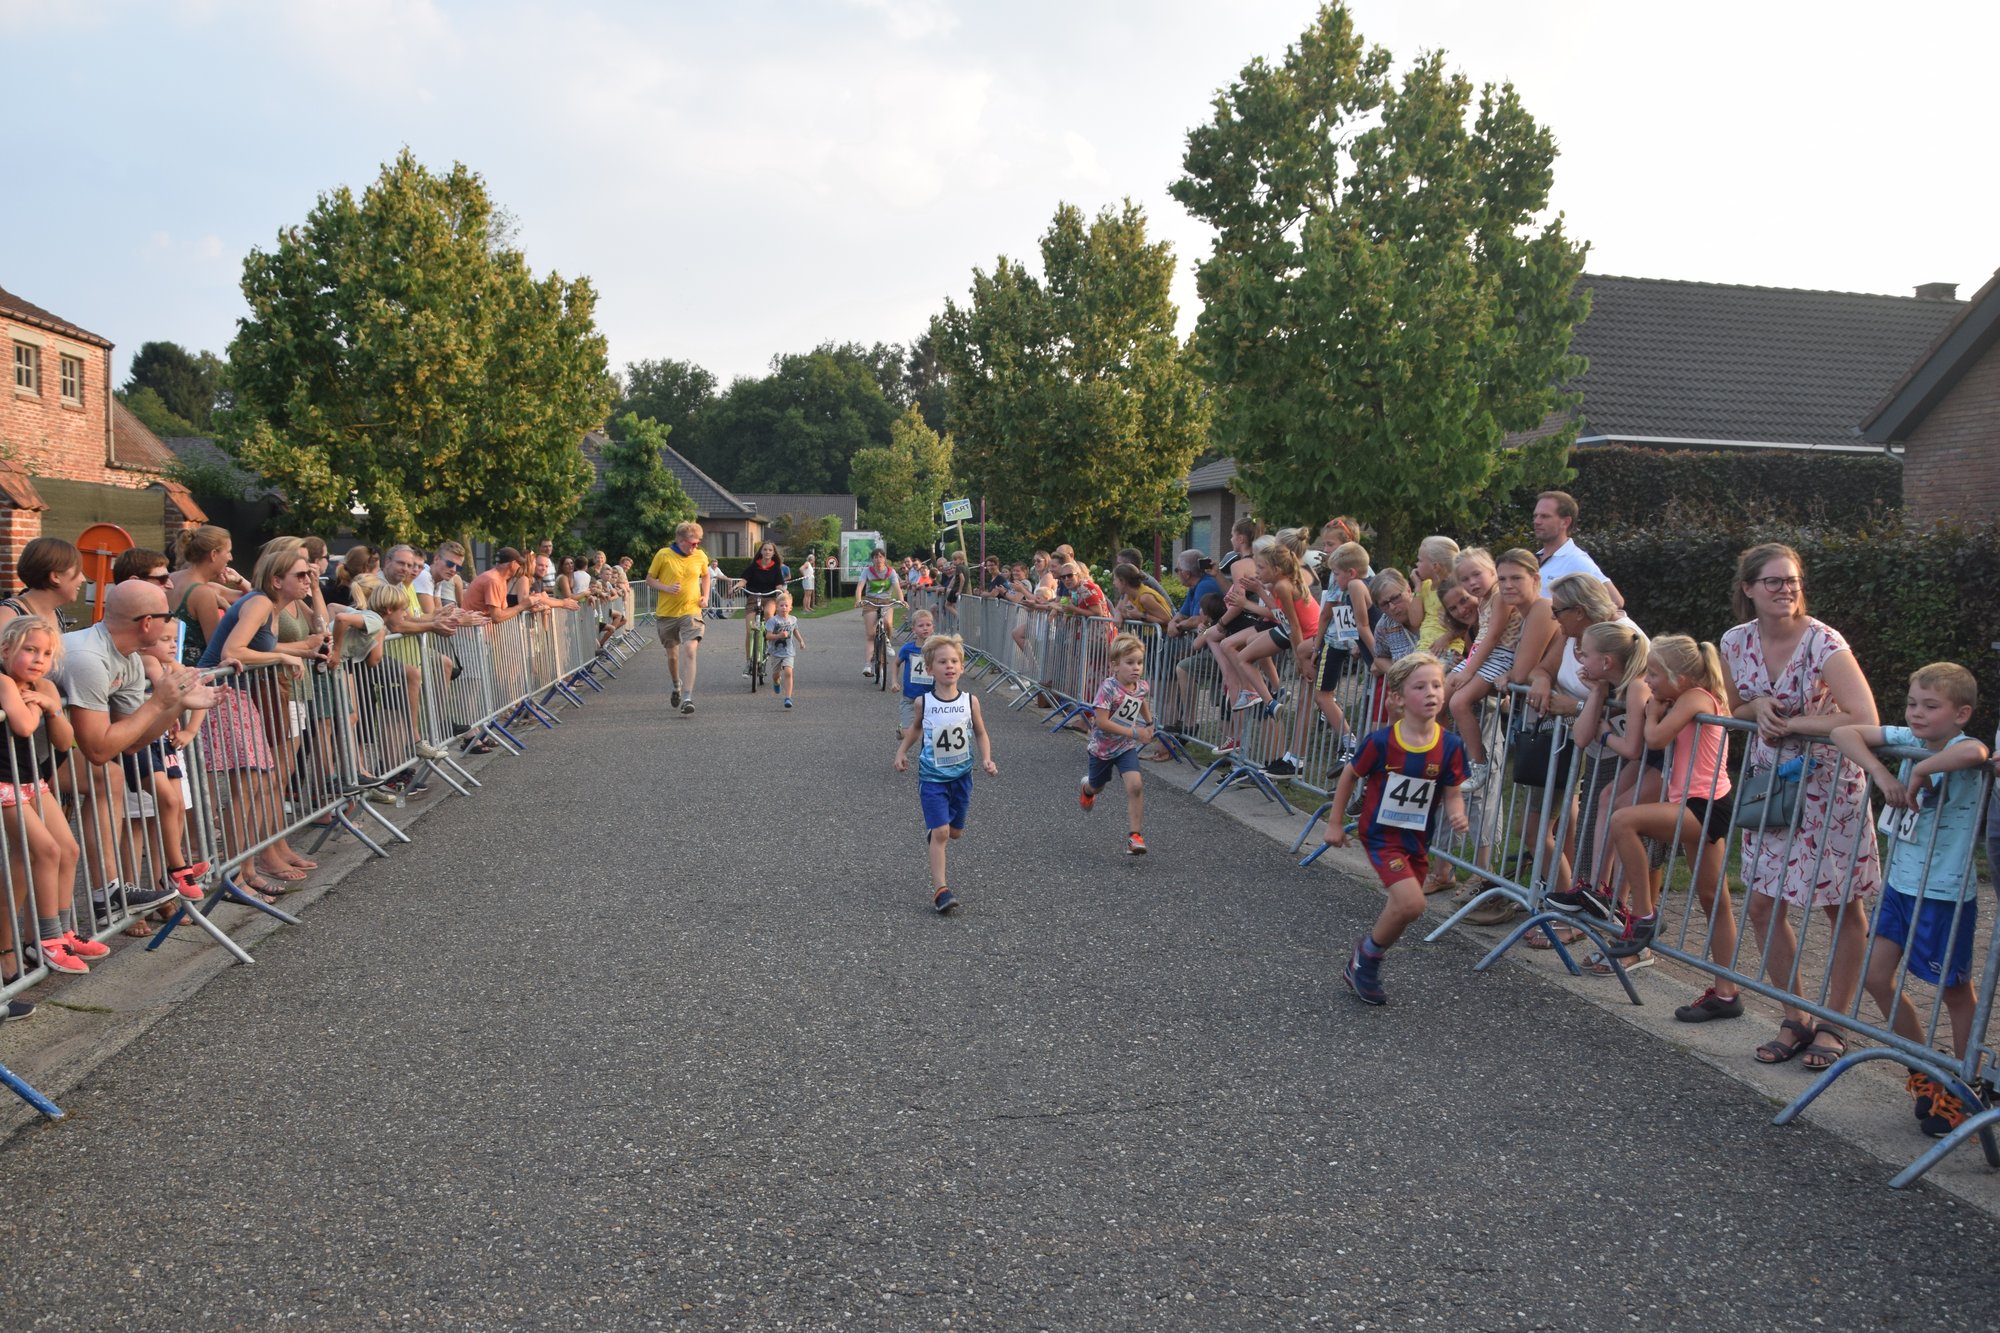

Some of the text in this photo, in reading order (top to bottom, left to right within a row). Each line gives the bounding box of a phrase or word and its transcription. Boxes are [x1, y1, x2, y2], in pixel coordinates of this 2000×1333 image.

[946, 504, 970, 517] START
[931, 705, 965, 714] RACING
[1118, 698, 1139, 722] 52
[936, 726, 966, 752] 43
[1389, 778, 1431, 809] 44
